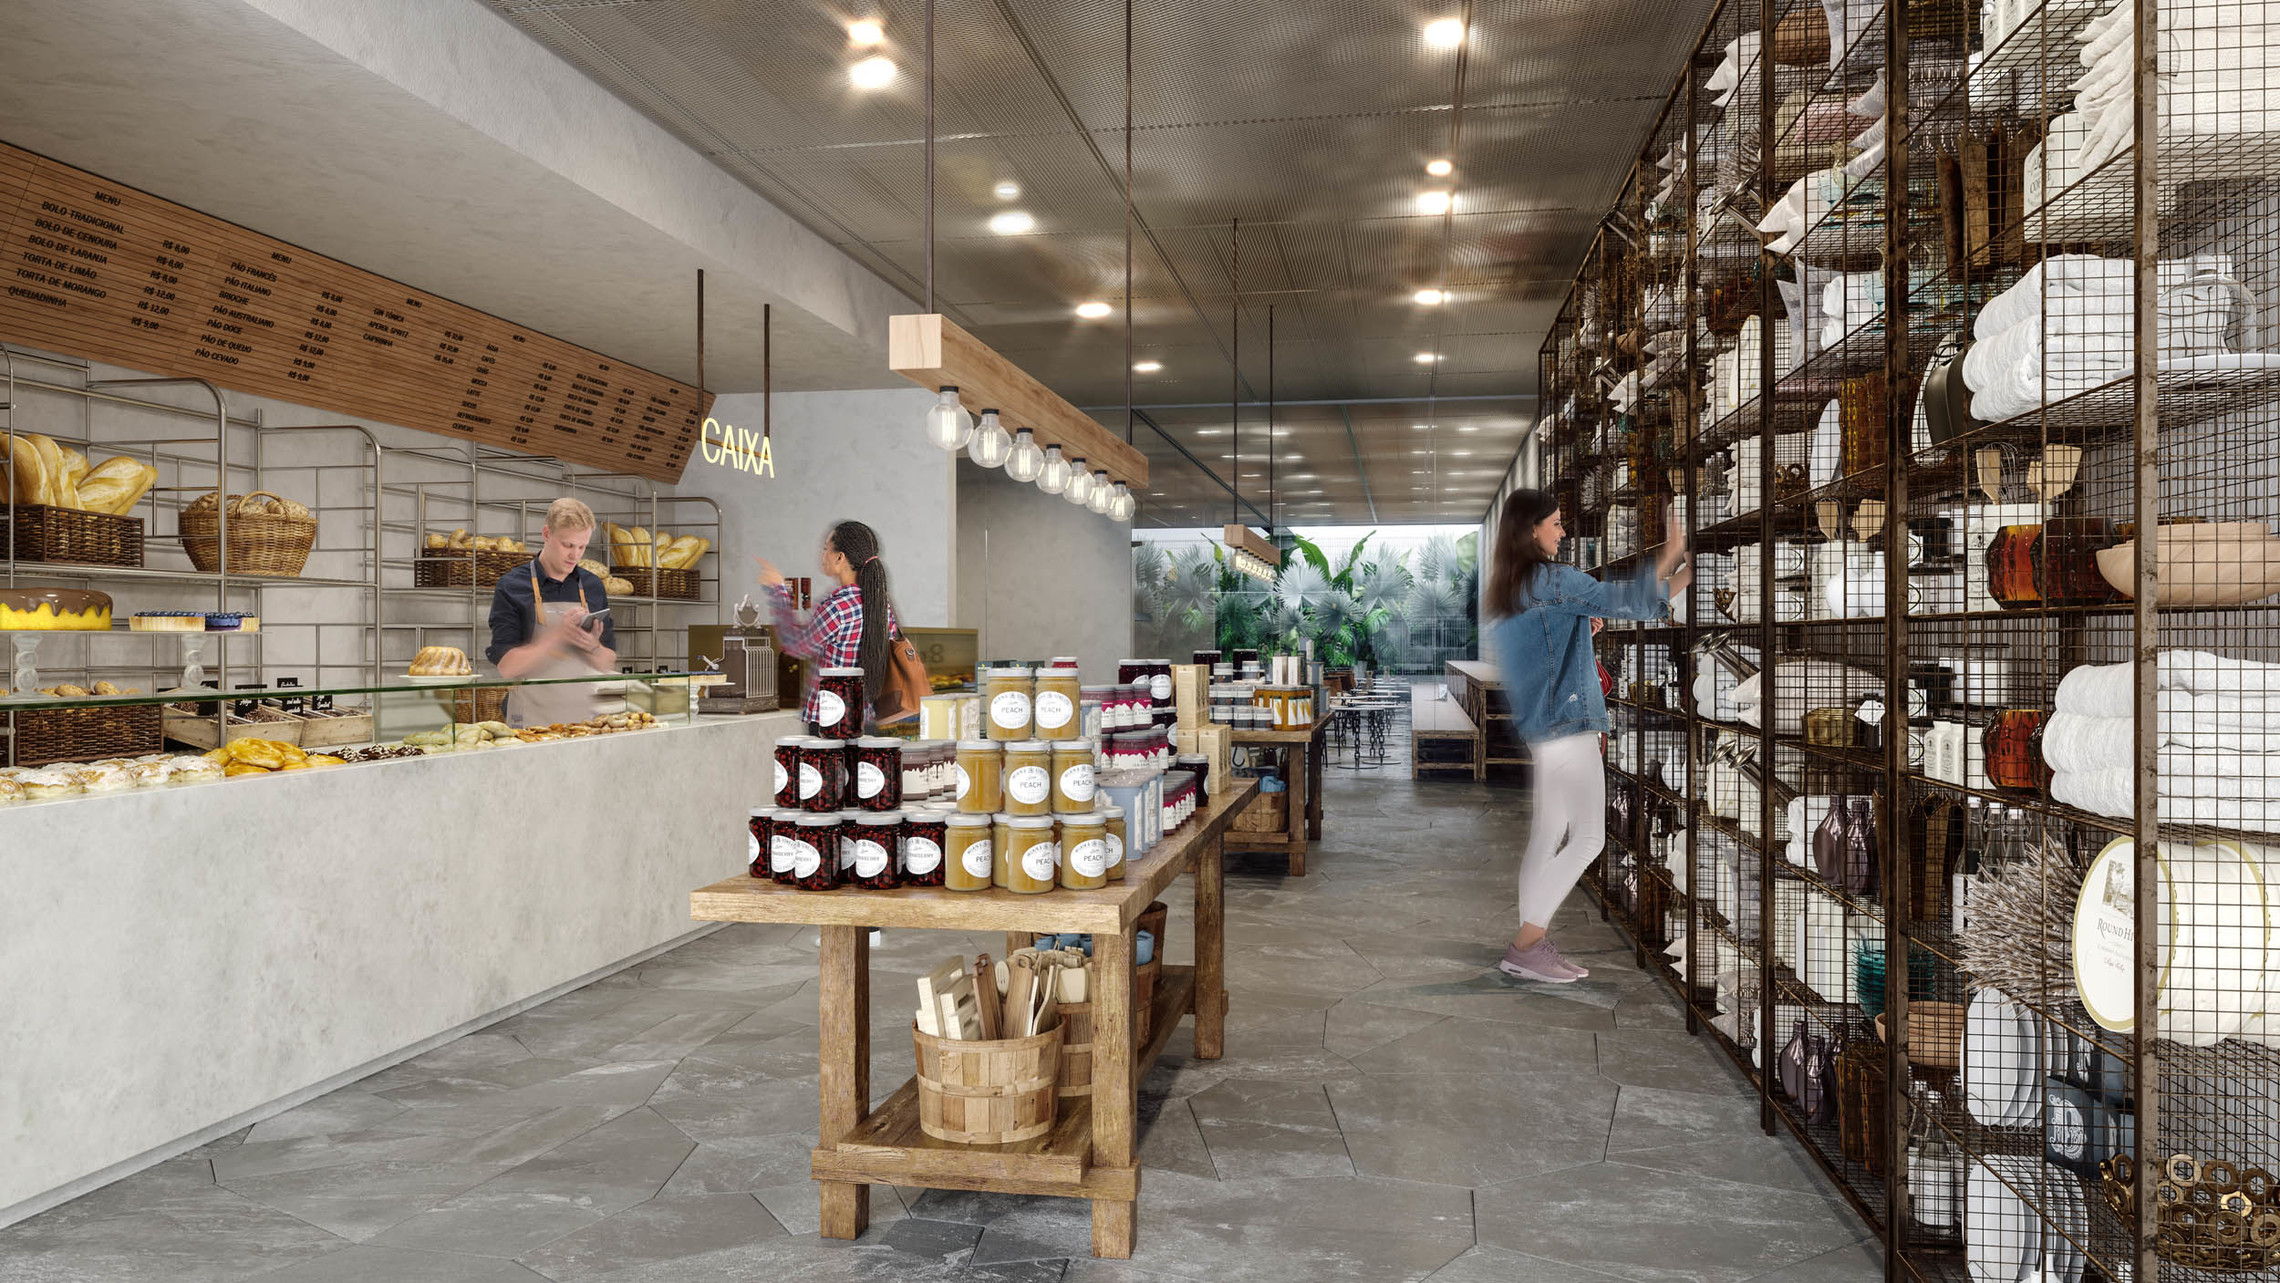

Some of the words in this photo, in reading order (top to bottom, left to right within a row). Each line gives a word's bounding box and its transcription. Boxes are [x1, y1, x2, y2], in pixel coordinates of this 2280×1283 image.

[95, 191, 121, 206] MENU
[41, 201, 67, 216] BOLO
[69, 209, 125, 235] TRADICIONAL
[34, 218, 60, 233] BOLO
[62, 227, 76, 237] DE
[77, 231, 118, 250] CENOURA
[28, 235, 54, 249] BOLO
[56, 243, 68, 253] DE
[70, 247, 108, 265] LARANJA
[162, 240, 173, 249] R$
[22, 251, 52, 267] TORTA
[54, 261, 68, 271] DE
[156, 255, 167, 265] R$
[271, 251, 292, 264] MENU
[150, 270, 160, 280] R$
[16, 268, 46, 283] TORTA
[48, 277, 61, 287] DE
[62, 280, 107, 299] MORANGO
[144, 286, 154, 295] R$
[240, 281, 272, 296] ITALIANO
[219, 290, 249, 305] BRIOCHE
[406, 298, 422, 308] MENU
[137, 301, 149, 310] R$
[131, 317, 142, 326] R$
[228, 310, 275, 328] AUSTRALIANO
[217, 338, 228, 347] DE
[211, 352, 239, 365] CEVADO
[702, 418, 775, 478] CAIXA
[1019, 781, 1042, 789] PEACH
[2097, 918, 2124, 940] ROUND
